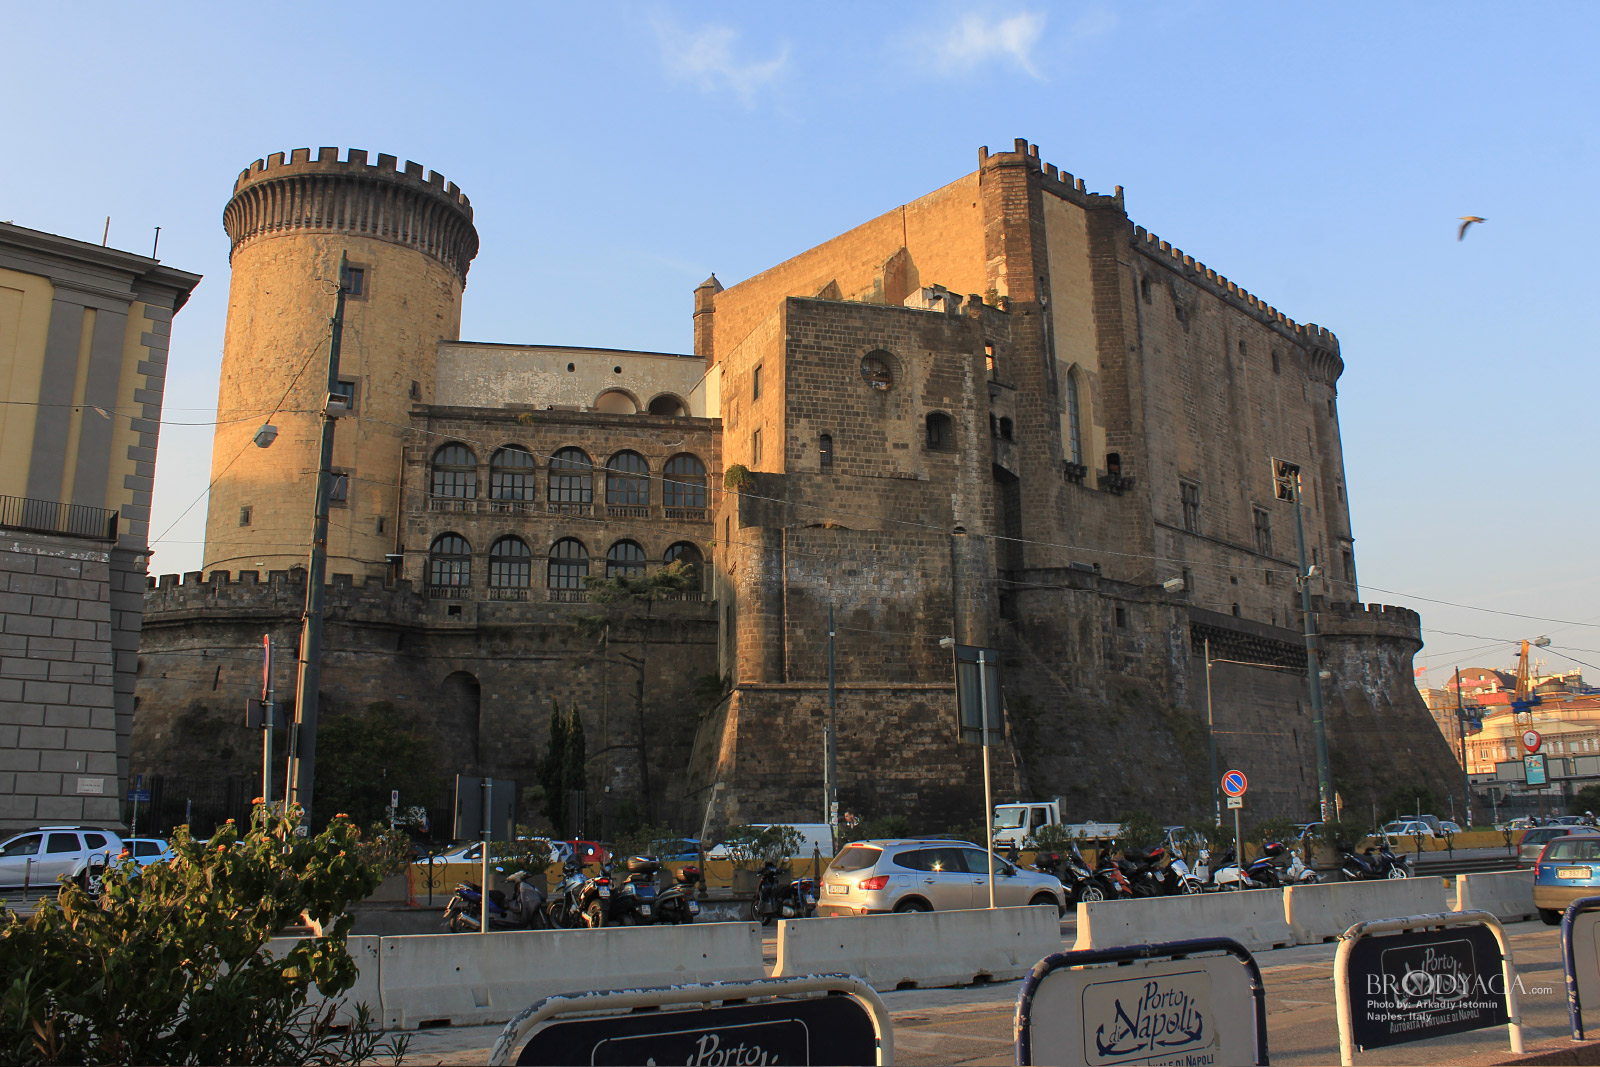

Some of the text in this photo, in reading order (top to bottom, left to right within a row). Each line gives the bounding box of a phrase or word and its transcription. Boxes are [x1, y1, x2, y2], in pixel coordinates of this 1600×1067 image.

[1425, 948, 1453, 972] Porto
[1144, 981, 1184, 1011] Porto
[1109, 995, 1194, 1050] di Napoli
[1458, 1009, 1480, 1021] NAPOLI
[696, 1034, 760, 1066] Porto
[1186, 1054, 1214, 1066] NAPOLI
